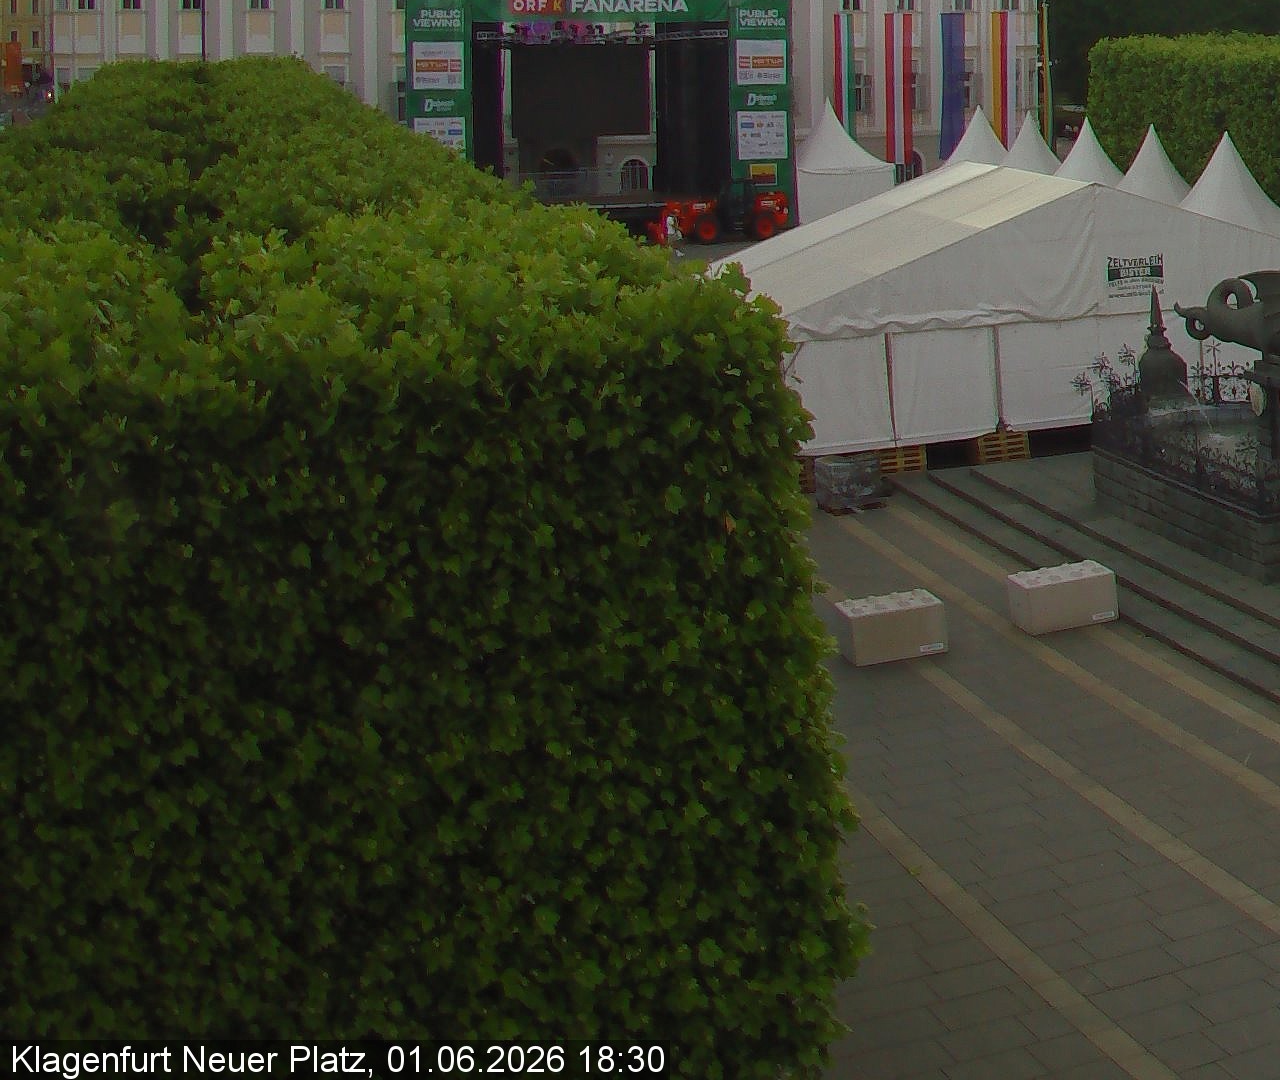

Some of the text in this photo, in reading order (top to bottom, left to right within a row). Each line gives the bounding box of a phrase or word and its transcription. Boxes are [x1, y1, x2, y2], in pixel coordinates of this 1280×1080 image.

[513, 0, 547, 12] ORF
[420, 9, 461, 18] PUBLIC
[740, 9, 779, 18] PUBLIC
[413, 18, 461, 27] VIEWING
[740, 18, 786, 27] VIEWING
[1107, 253, 1163, 268] ZELTVERLEIH
